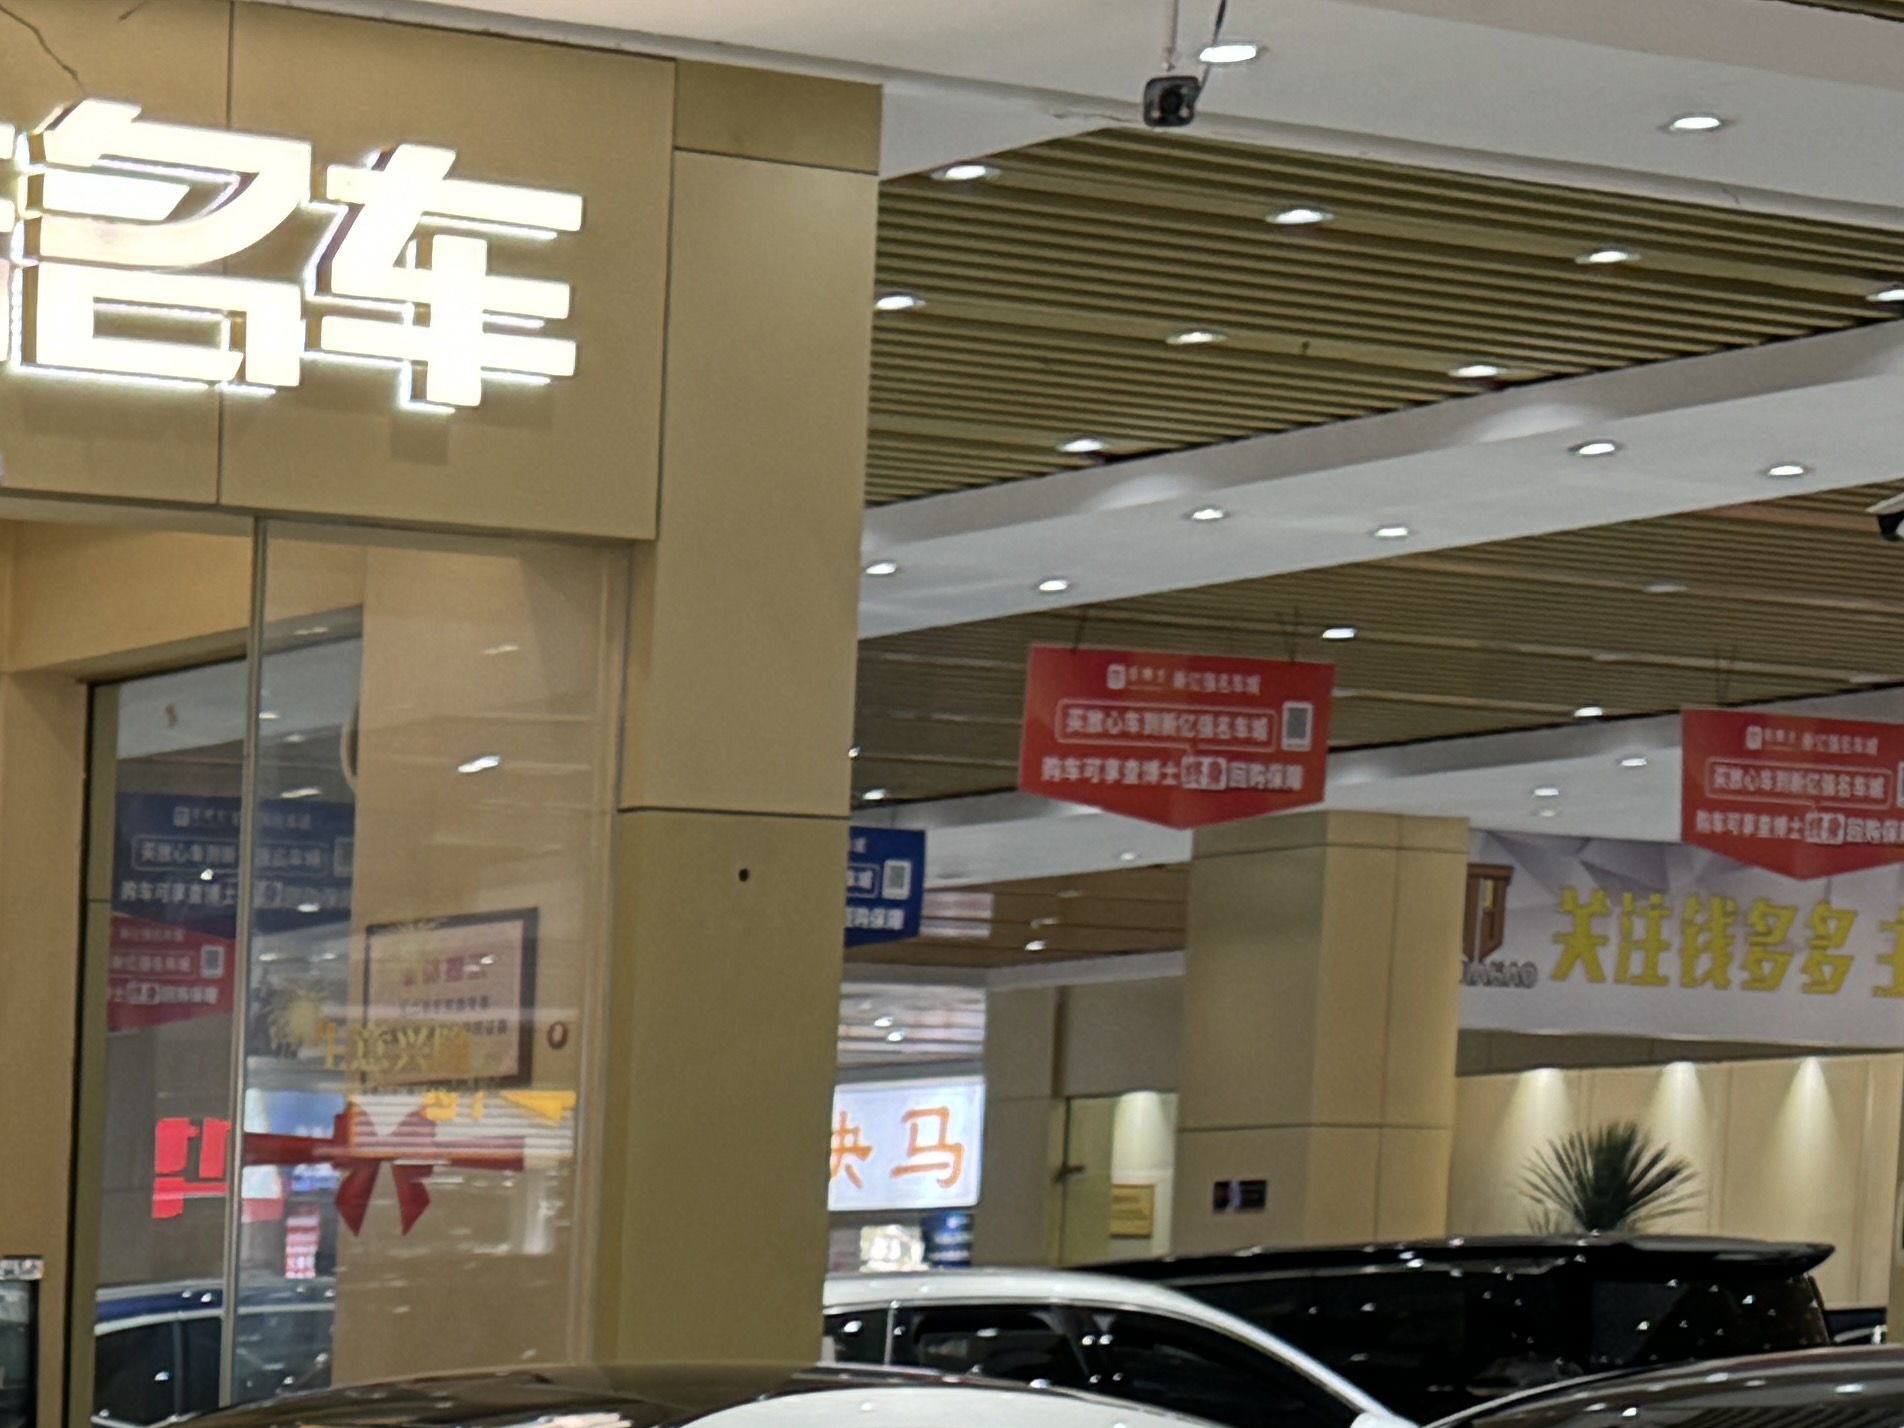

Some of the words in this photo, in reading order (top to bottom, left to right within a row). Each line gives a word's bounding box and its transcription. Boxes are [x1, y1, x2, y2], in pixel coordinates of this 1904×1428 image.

[1551, 885, 1859, 995] 关注钱多多
